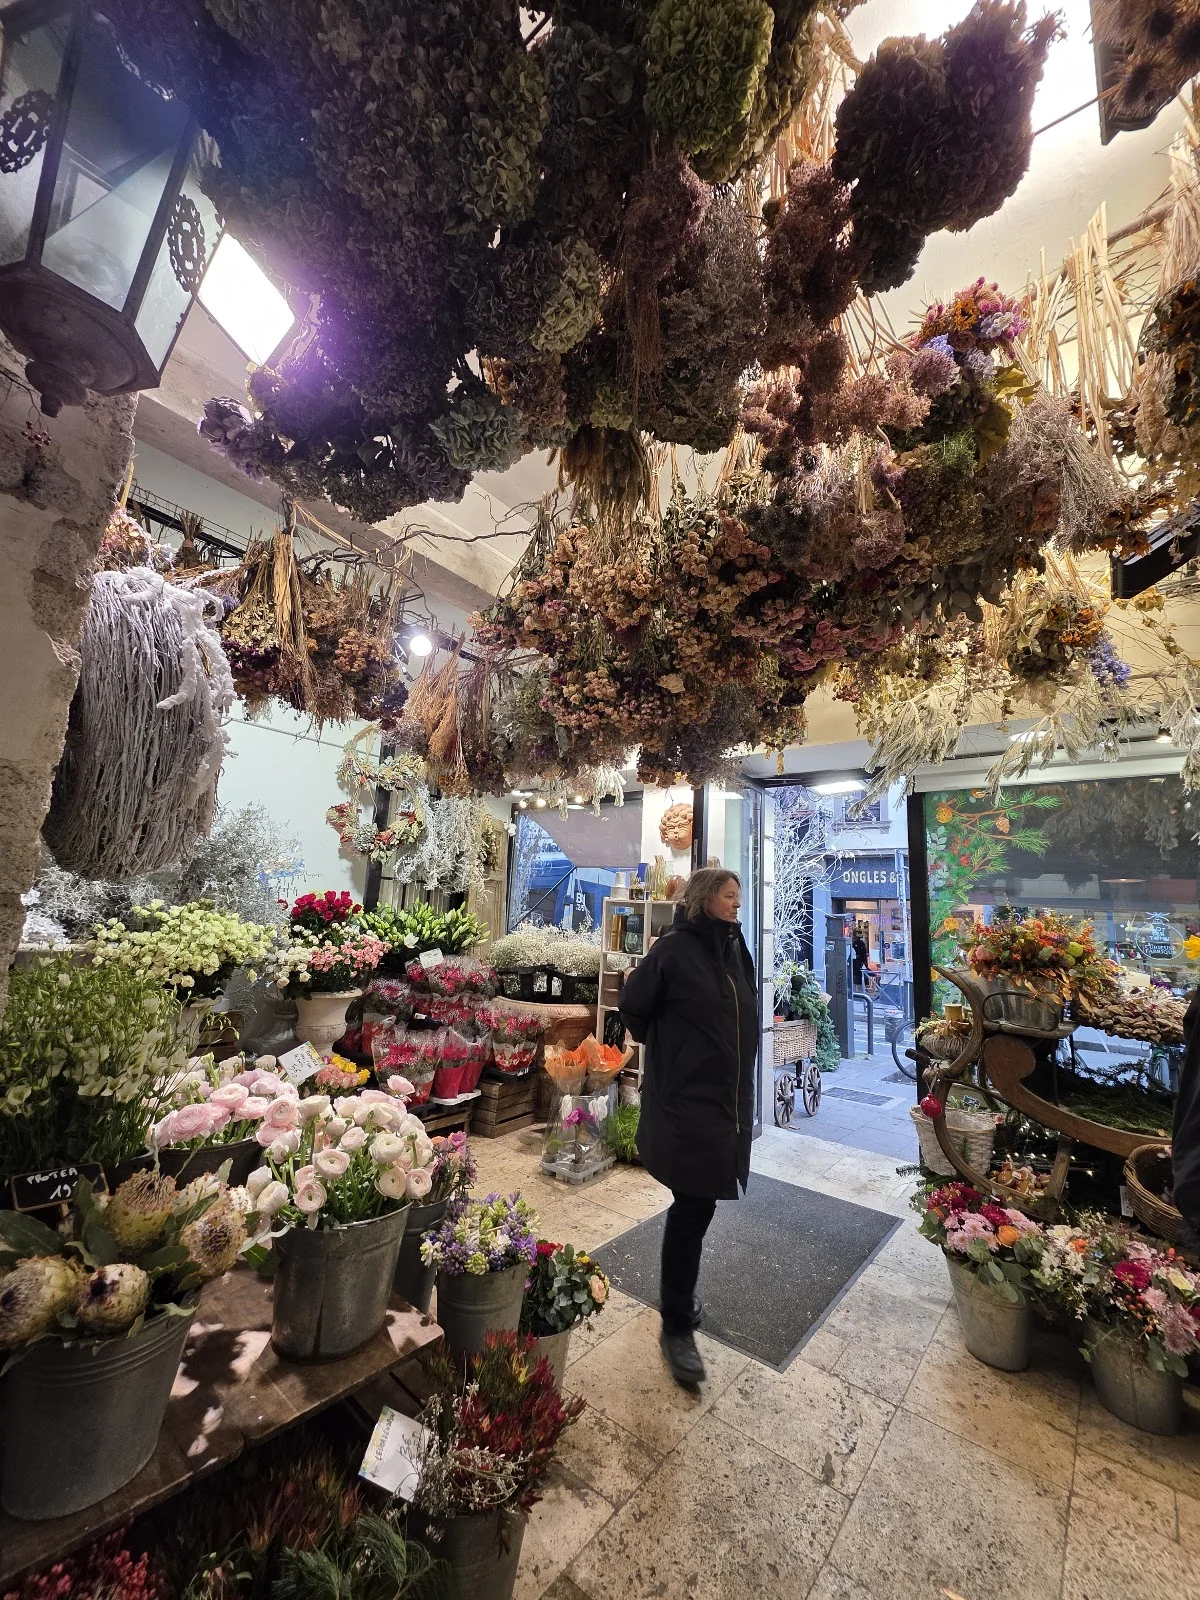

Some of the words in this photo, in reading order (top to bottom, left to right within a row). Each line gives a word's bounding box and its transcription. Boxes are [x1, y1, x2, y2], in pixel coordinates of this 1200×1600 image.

[843, 871, 887, 884] ONGLES
[890, 871, 897, 884] &
[27, 1168, 78, 1184] PROTEA
[50, 1181, 77, 1199] 19
